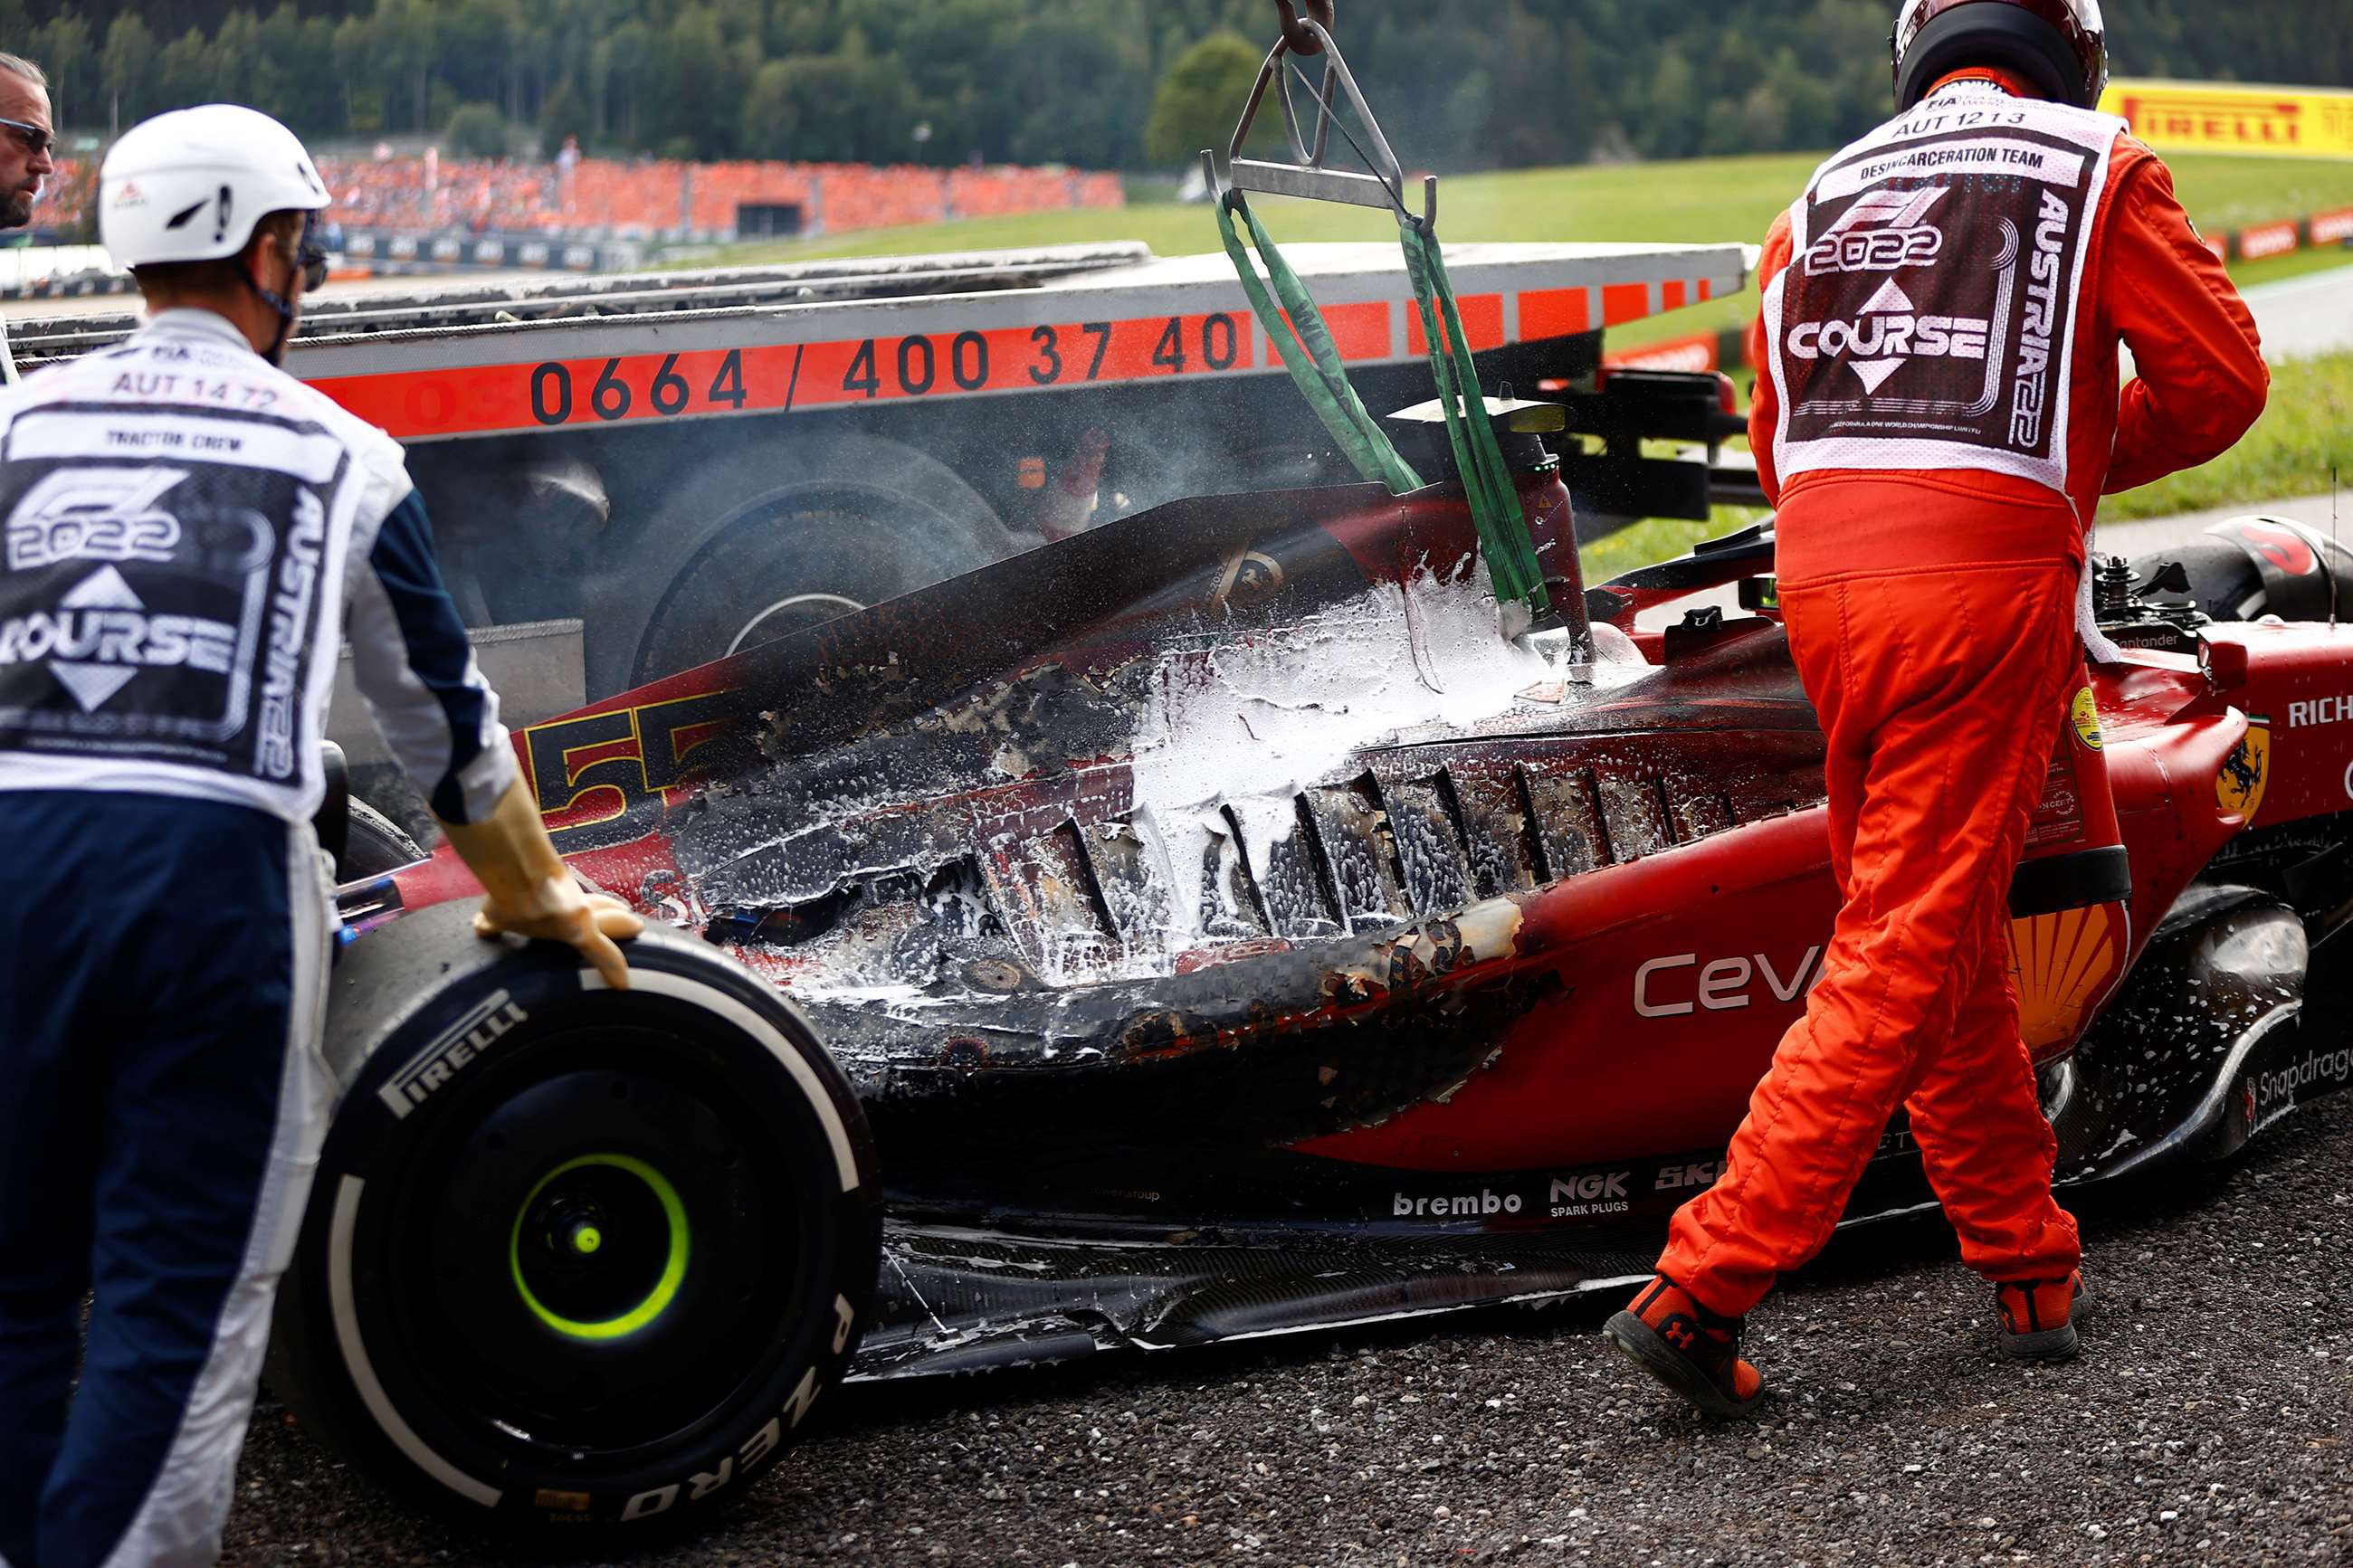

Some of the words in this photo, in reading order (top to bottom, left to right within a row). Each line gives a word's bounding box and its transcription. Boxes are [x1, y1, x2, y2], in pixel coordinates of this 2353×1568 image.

[1891, 115, 1948, 138] AUT
[2122, 97, 2300, 142] PIRELLI
[1860, 147, 1996, 180] DESINCARCERATION
[2001, 148, 2044, 169] TEAM
[1805, 224, 1943, 276] 2022
[1786, 315, 1988, 360] COURSE
[112, 372, 179, 395] AUT
[530, 348, 747, 425] 0664
[843, 329, 989, 398] 400
[1029, 321, 1112, 385] 37
[1152, 312, 1236, 373] 40
[192, 435, 243, 451] CREW
[6, 509, 182, 571] 2022
[2289, 695, 2353, 727] RICH
[377, 988, 529, 1120] PIRELLI
[2260, 1050, 2353, 1106] Snapdrag
[1550, 1172, 1631, 1202] NGK
[1655, 1161, 1727, 1190] SK
[1394, 1189, 1522, 1216] brembo
[1550, 1204, 1589, 1218] SPARK
[1592, 1201, 1629, 1214] PLUGS
[620, 1365, 822, 1522] ZERO
